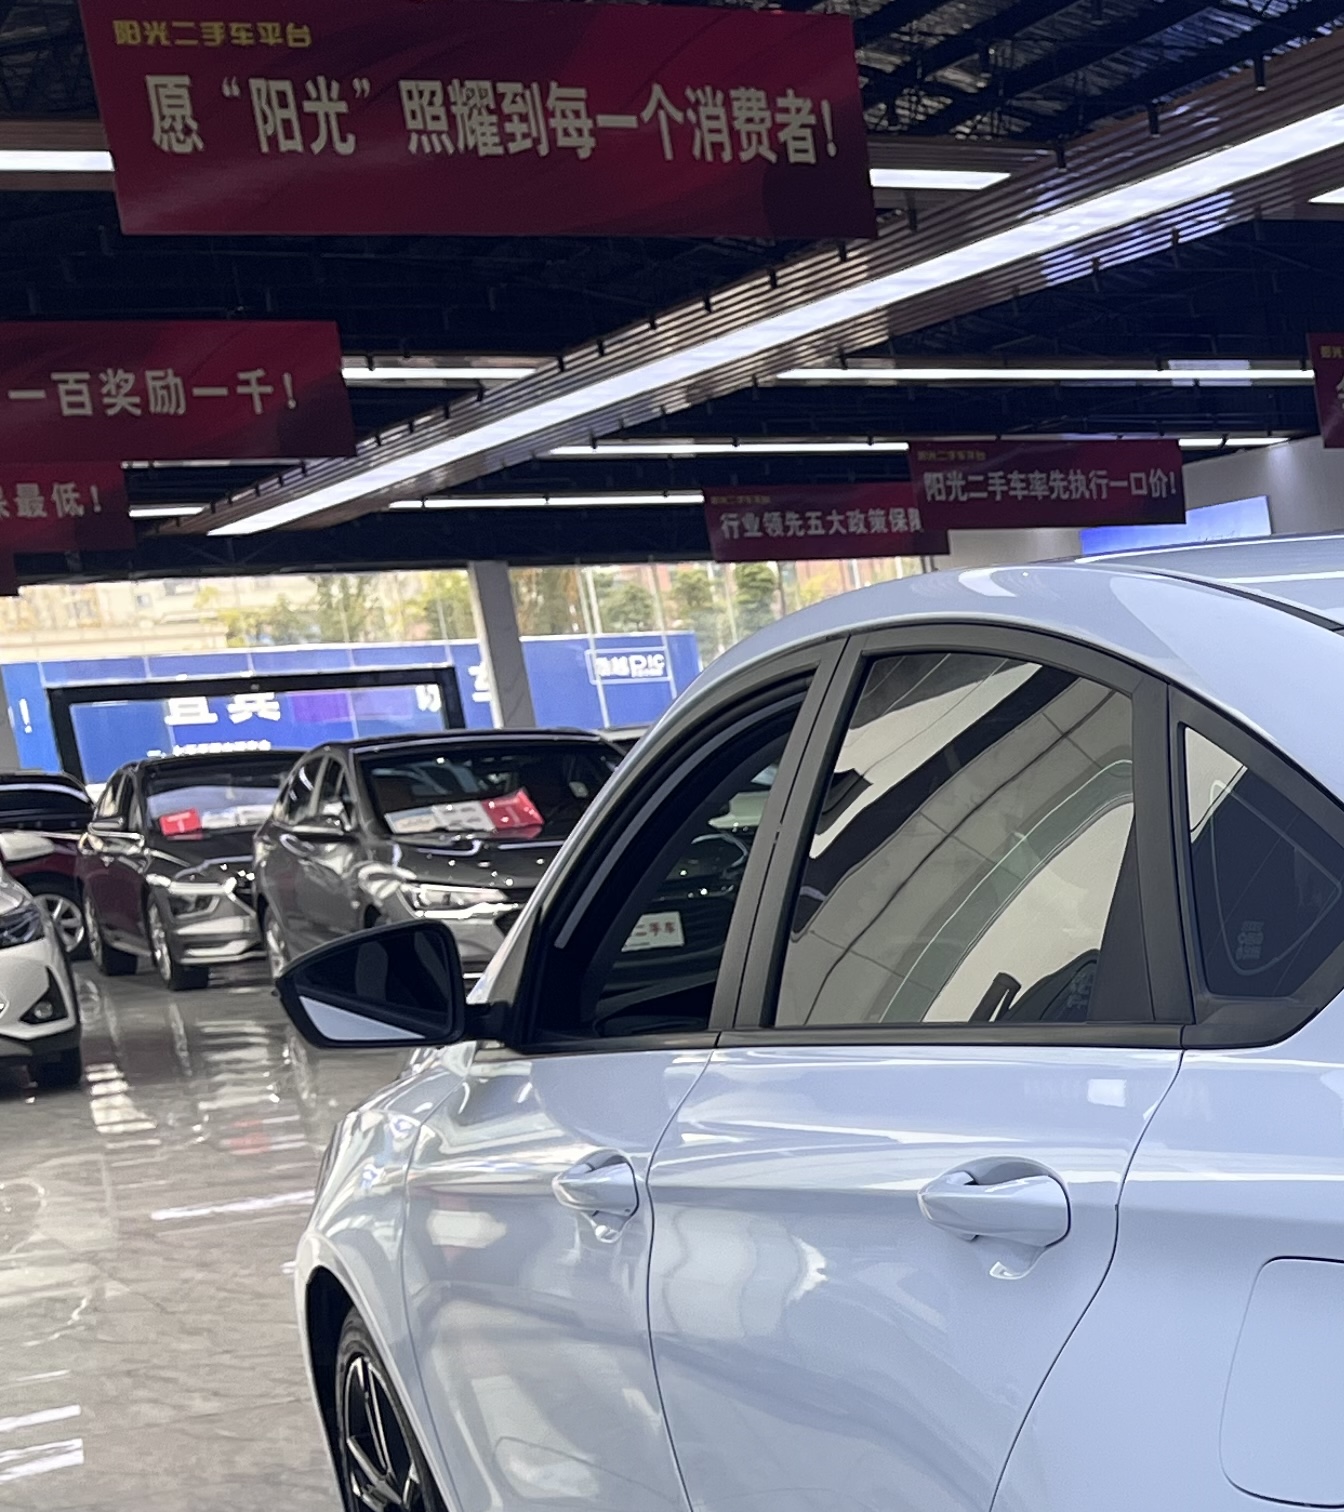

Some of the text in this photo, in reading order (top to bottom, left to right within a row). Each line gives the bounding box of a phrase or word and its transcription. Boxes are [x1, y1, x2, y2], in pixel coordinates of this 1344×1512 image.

[112, 19, 313, 48] 阳光二手车平台
[8, 367, 297, 416] 一百奖励一千！
[923, 470, 1177, 502] 阳光二手车率先执行一口价！
